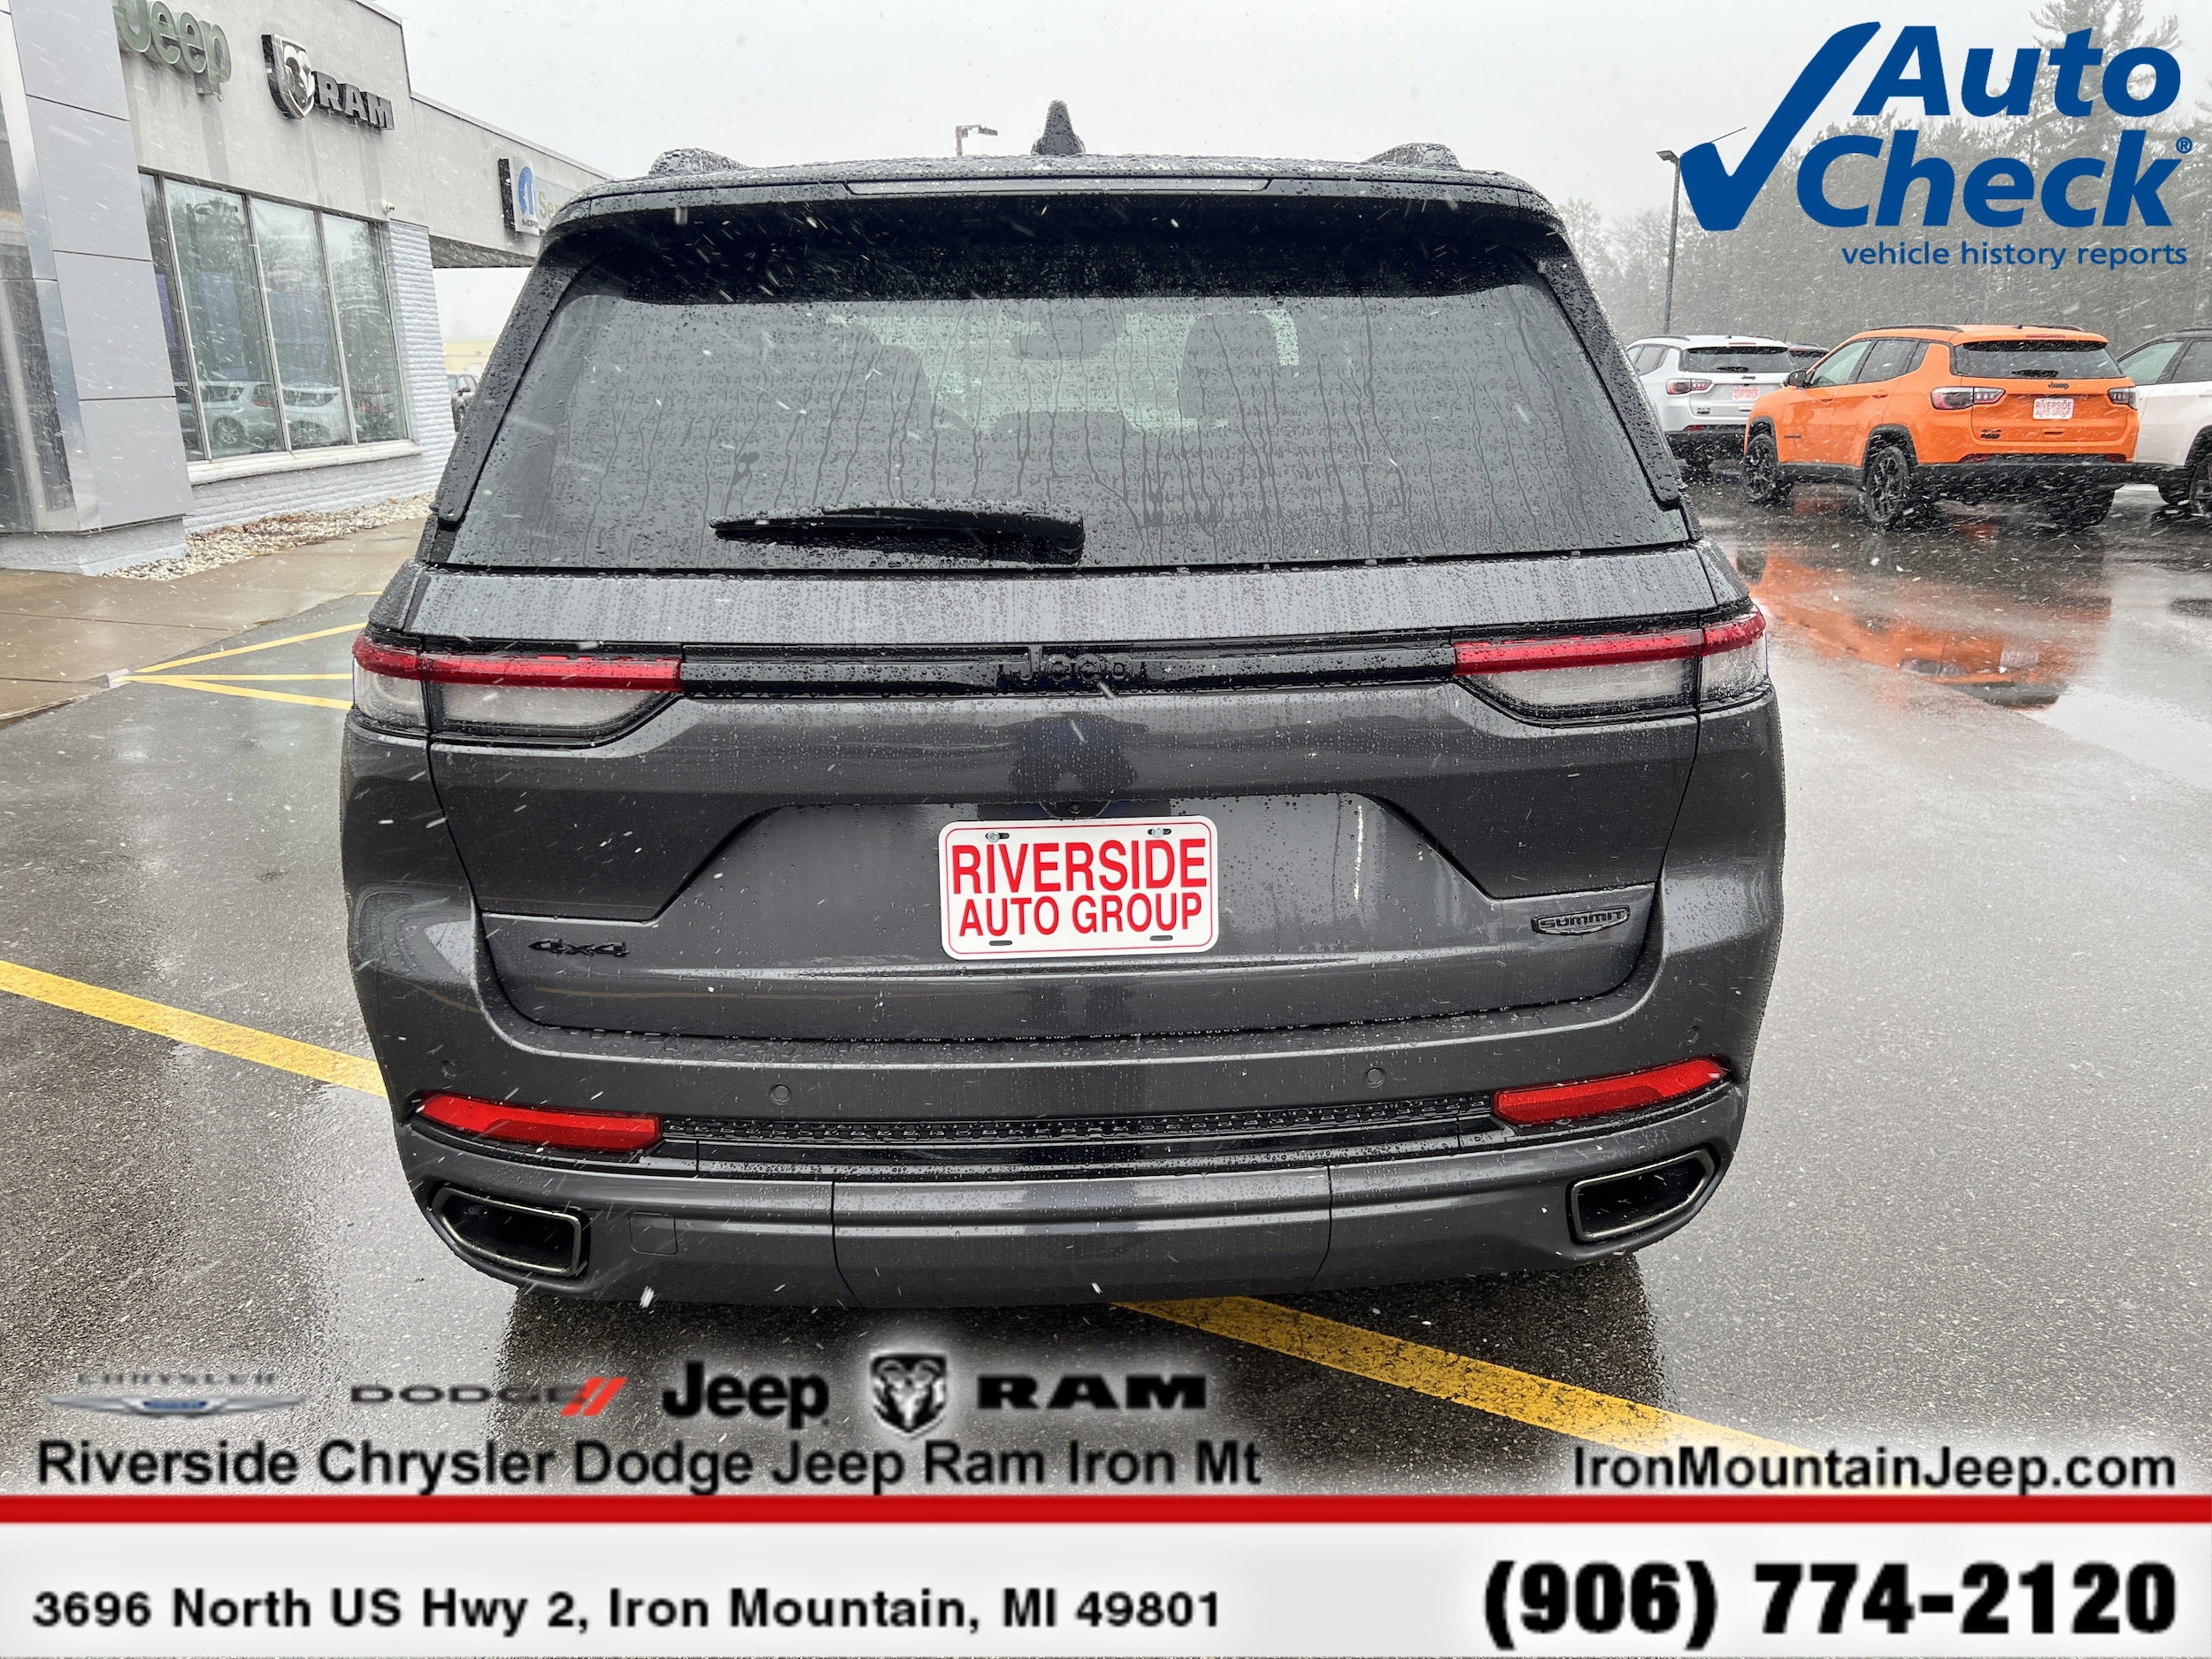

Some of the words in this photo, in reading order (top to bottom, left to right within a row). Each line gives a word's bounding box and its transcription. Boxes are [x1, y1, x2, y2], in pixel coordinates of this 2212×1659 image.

[113, 0, 231, 96] Jeep
[311, 70, 395, 130] RAM
[2035, 401, 2071, 410] RIVERSIDE
[951, 838, 1207, 895] RIVERSIDE
[959, 895, 1059, 937] AUTO
[1071, 892, 1202, 933] GROUP
[1540, 909, 1625, 928] SUMMIT
